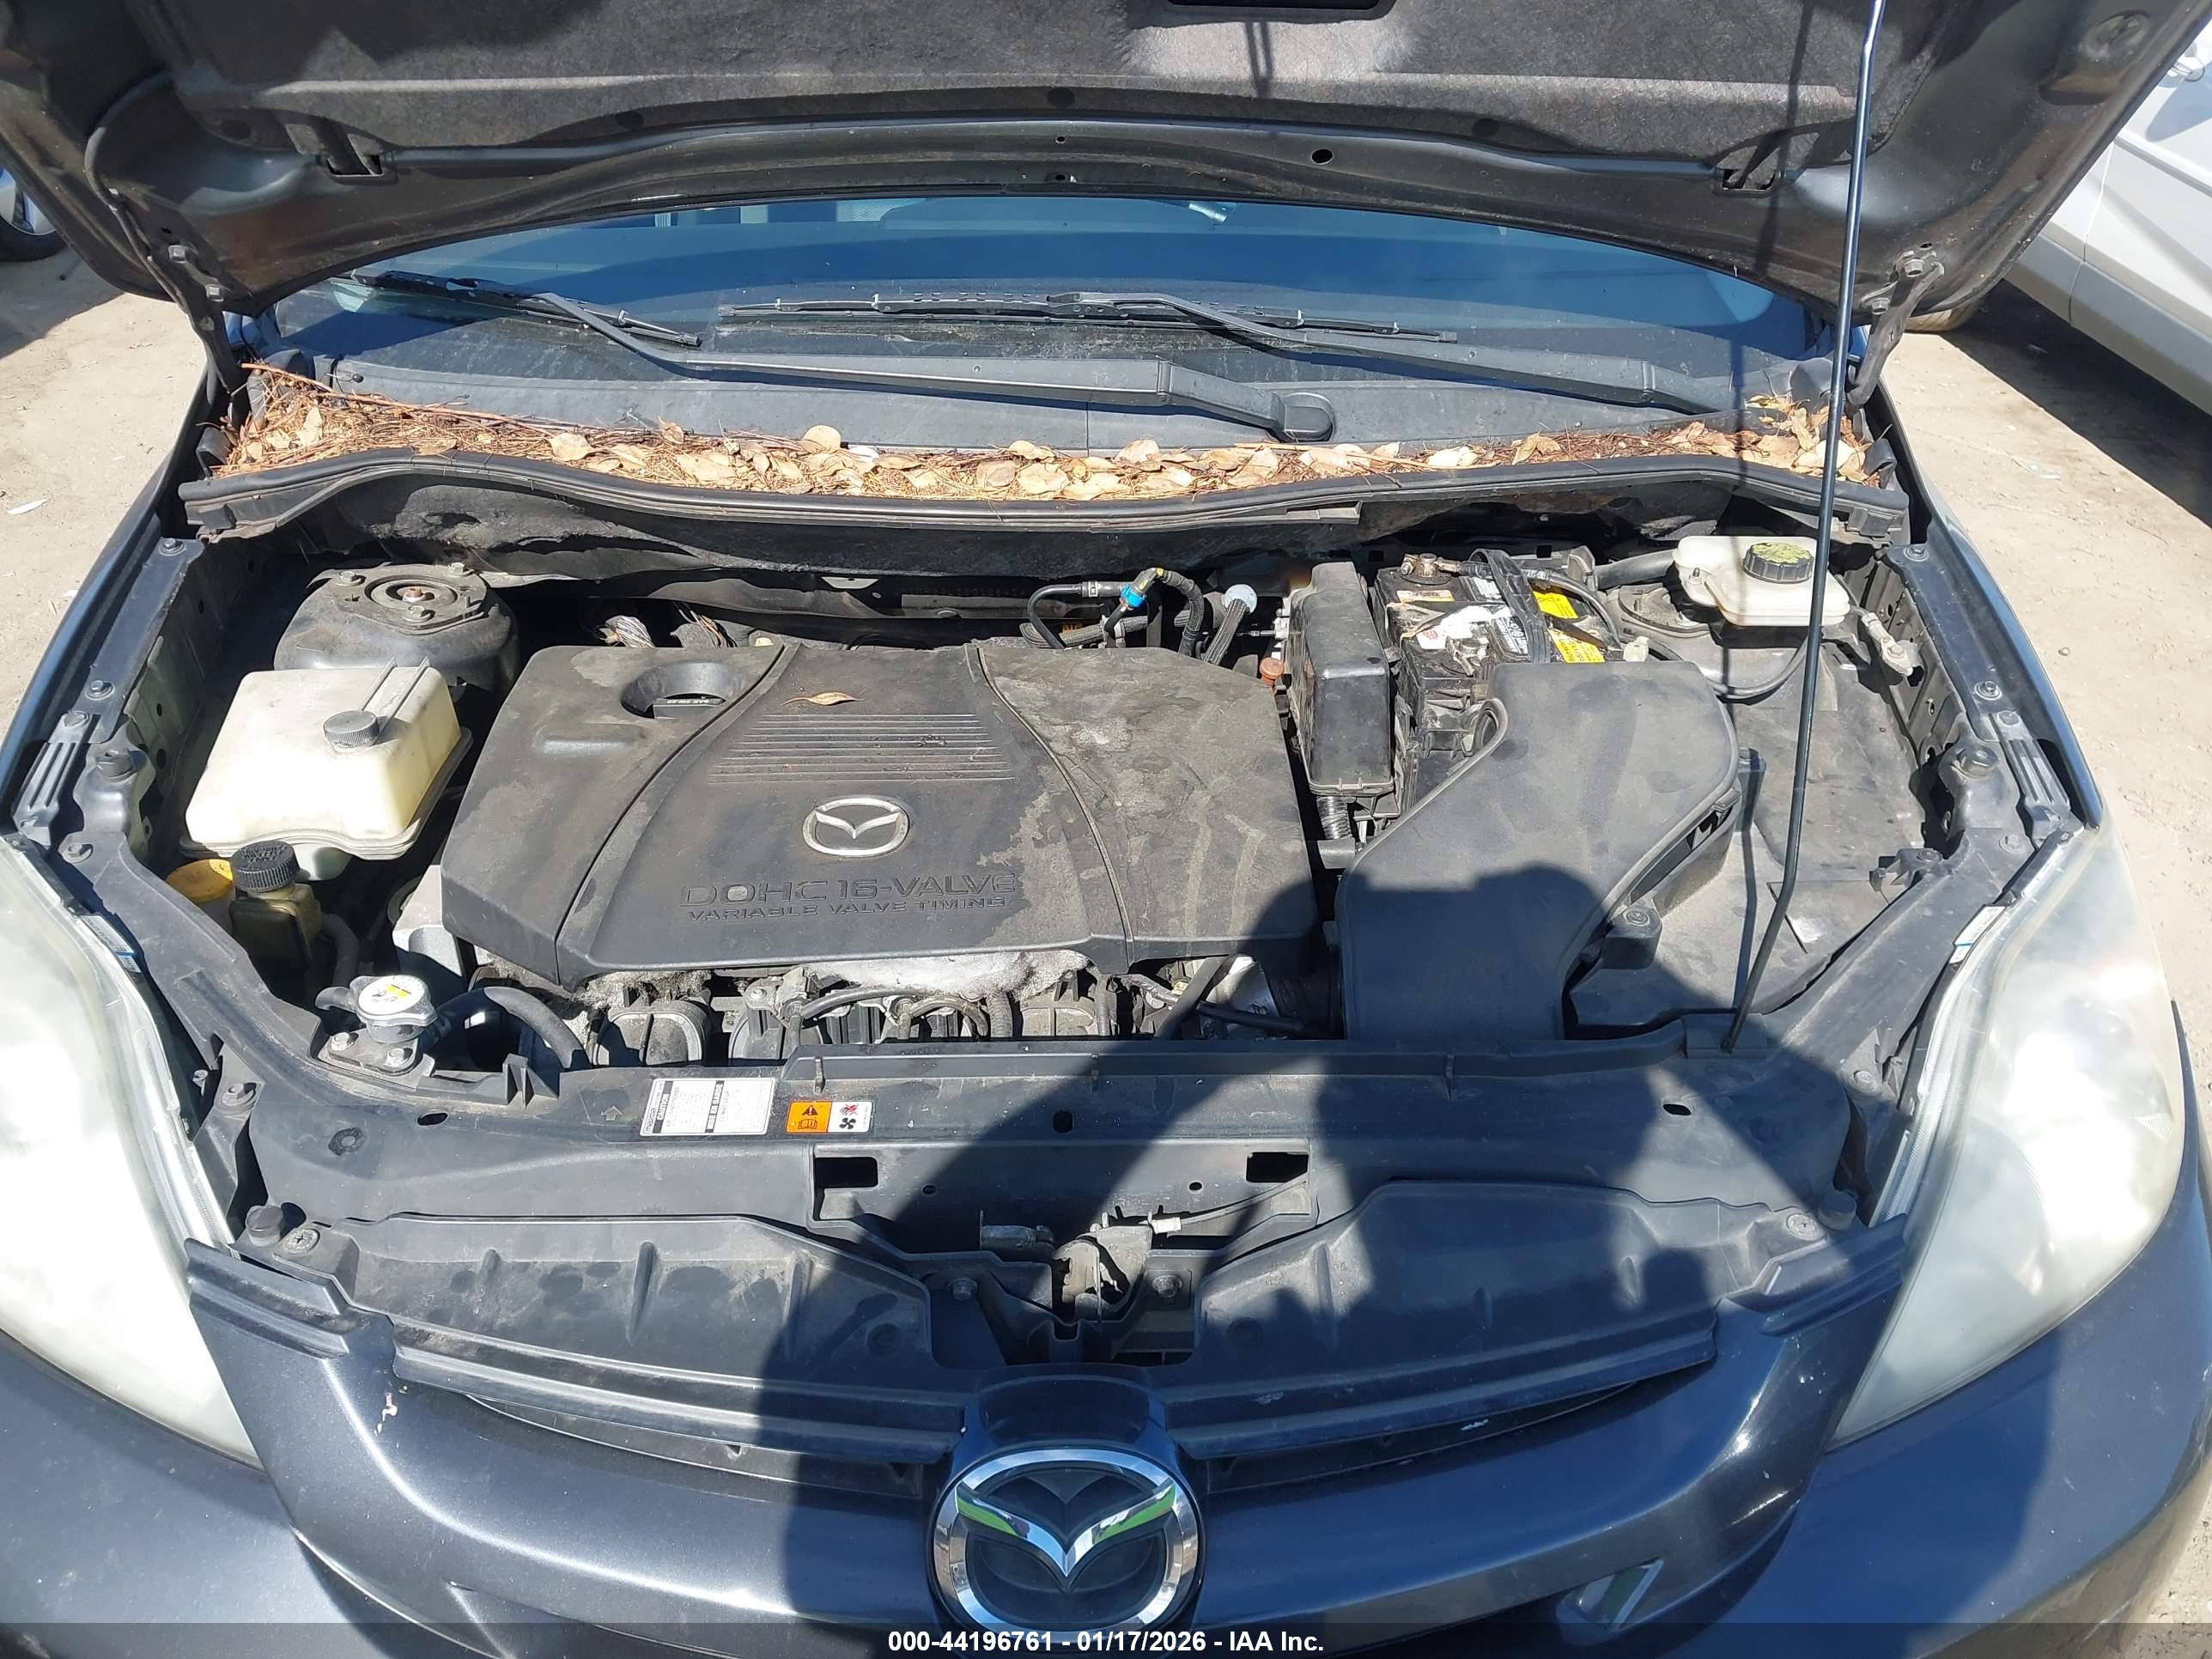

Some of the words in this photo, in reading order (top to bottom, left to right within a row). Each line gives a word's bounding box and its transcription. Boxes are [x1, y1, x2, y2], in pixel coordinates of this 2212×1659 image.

[680, 879, 830, 908] DOHC
[838, 872, 1017, 899] 16-VALVE
[688, 904, 819, 921] VARIABLE
[829, 901, 908, 916] VALVE
[915, 896, 1006, 911] TIMING
[656, 1093, 670, 1120] CAUTION
[645, 1108, 656, 1132] mazda
